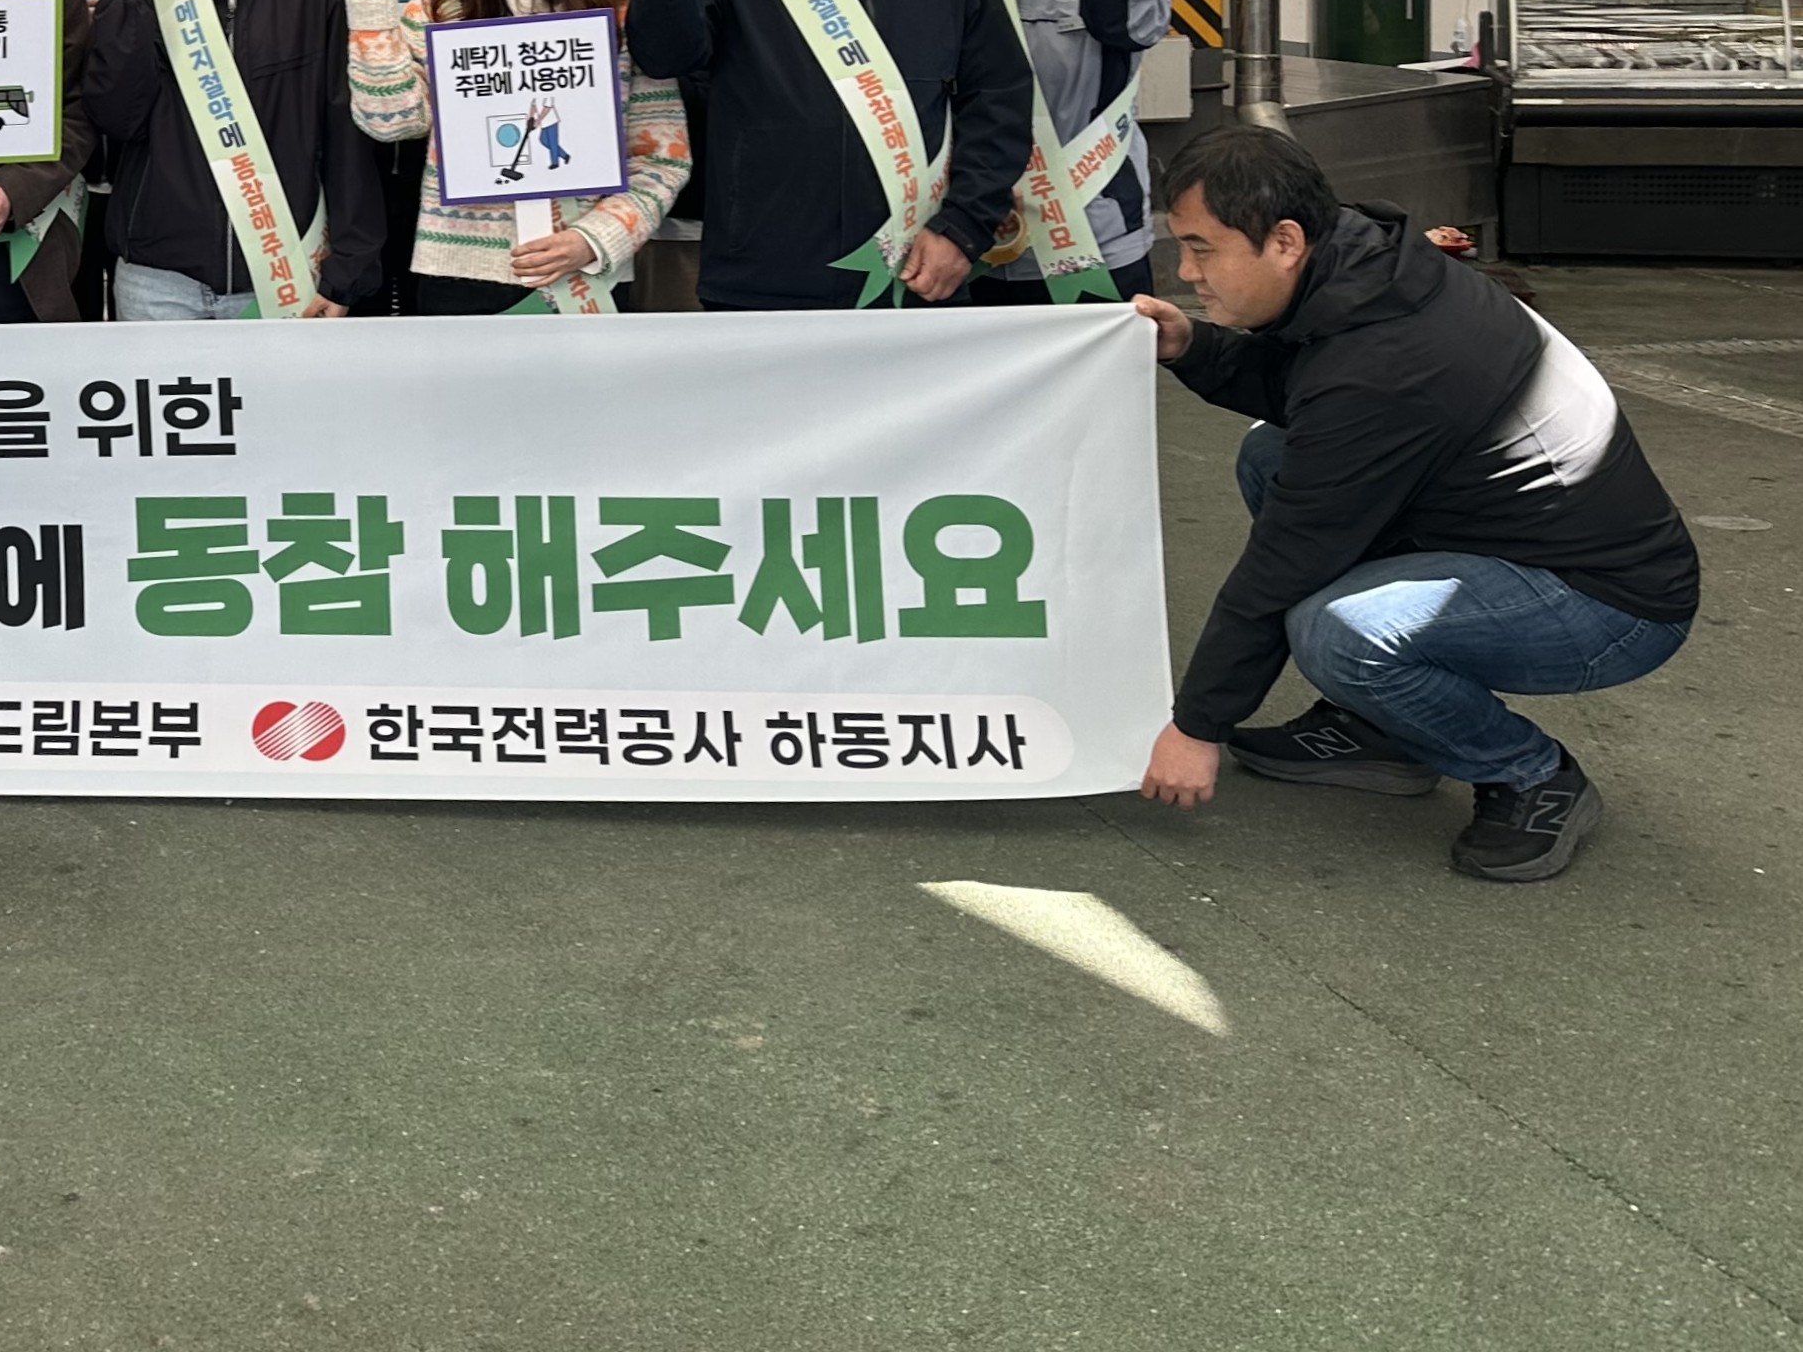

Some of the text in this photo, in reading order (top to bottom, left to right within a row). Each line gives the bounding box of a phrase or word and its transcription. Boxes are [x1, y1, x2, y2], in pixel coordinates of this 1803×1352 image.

[450, 38, 596, 72] 세탁기, 청소기는
[454, 64, 595, 98] 주말에 사용하기
[76, 376, 243, 458] 위한
[126, 492, 405, 637] 동참
[441, 494, 1048, 644] 해주세요
[366, 703, 743, 768] 한국전력공사
[765, 710, 1027, 770] 하동지사
